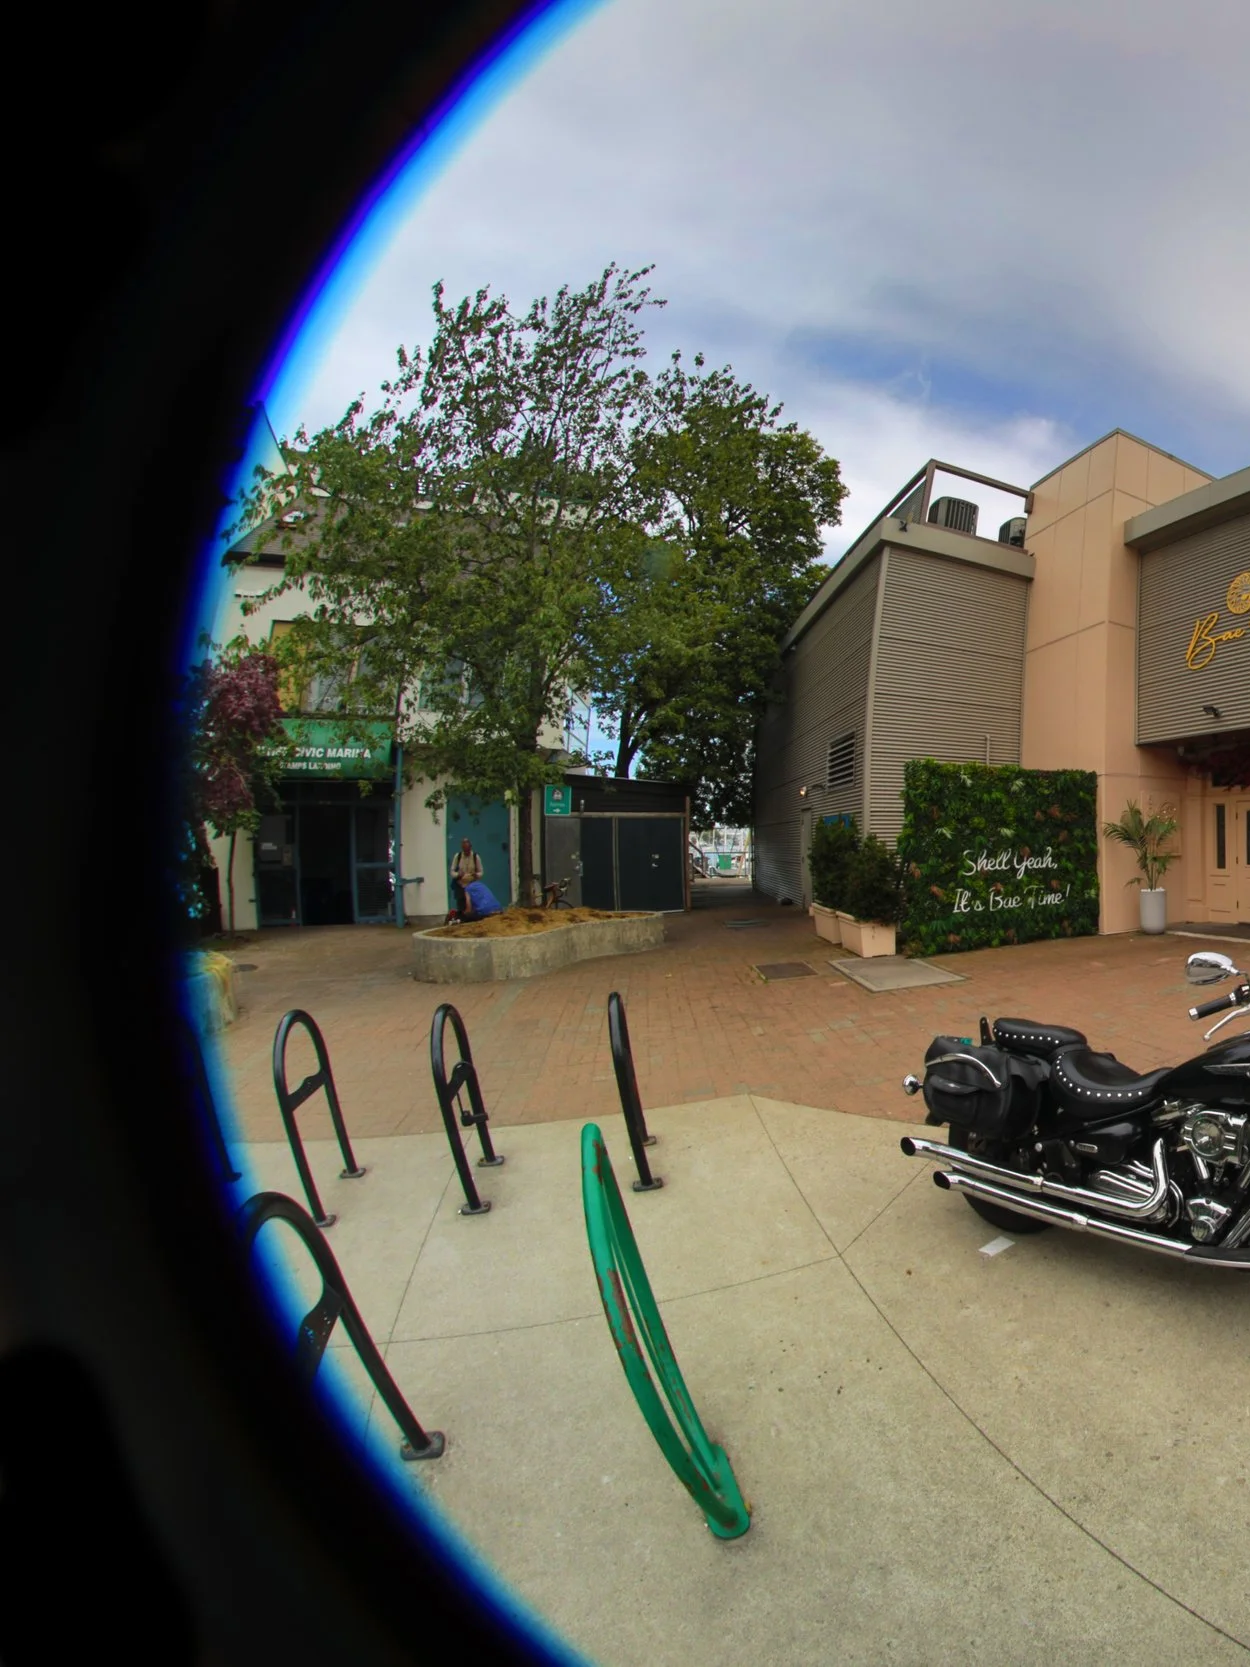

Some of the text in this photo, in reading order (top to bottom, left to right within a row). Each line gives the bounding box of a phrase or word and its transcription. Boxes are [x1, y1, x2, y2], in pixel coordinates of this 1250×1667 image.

[1186, 612, 1246, 670] Bae
[962, 848, 1012, 876] Shell
[952, 884, 1071, 913] It's Bae Time!
